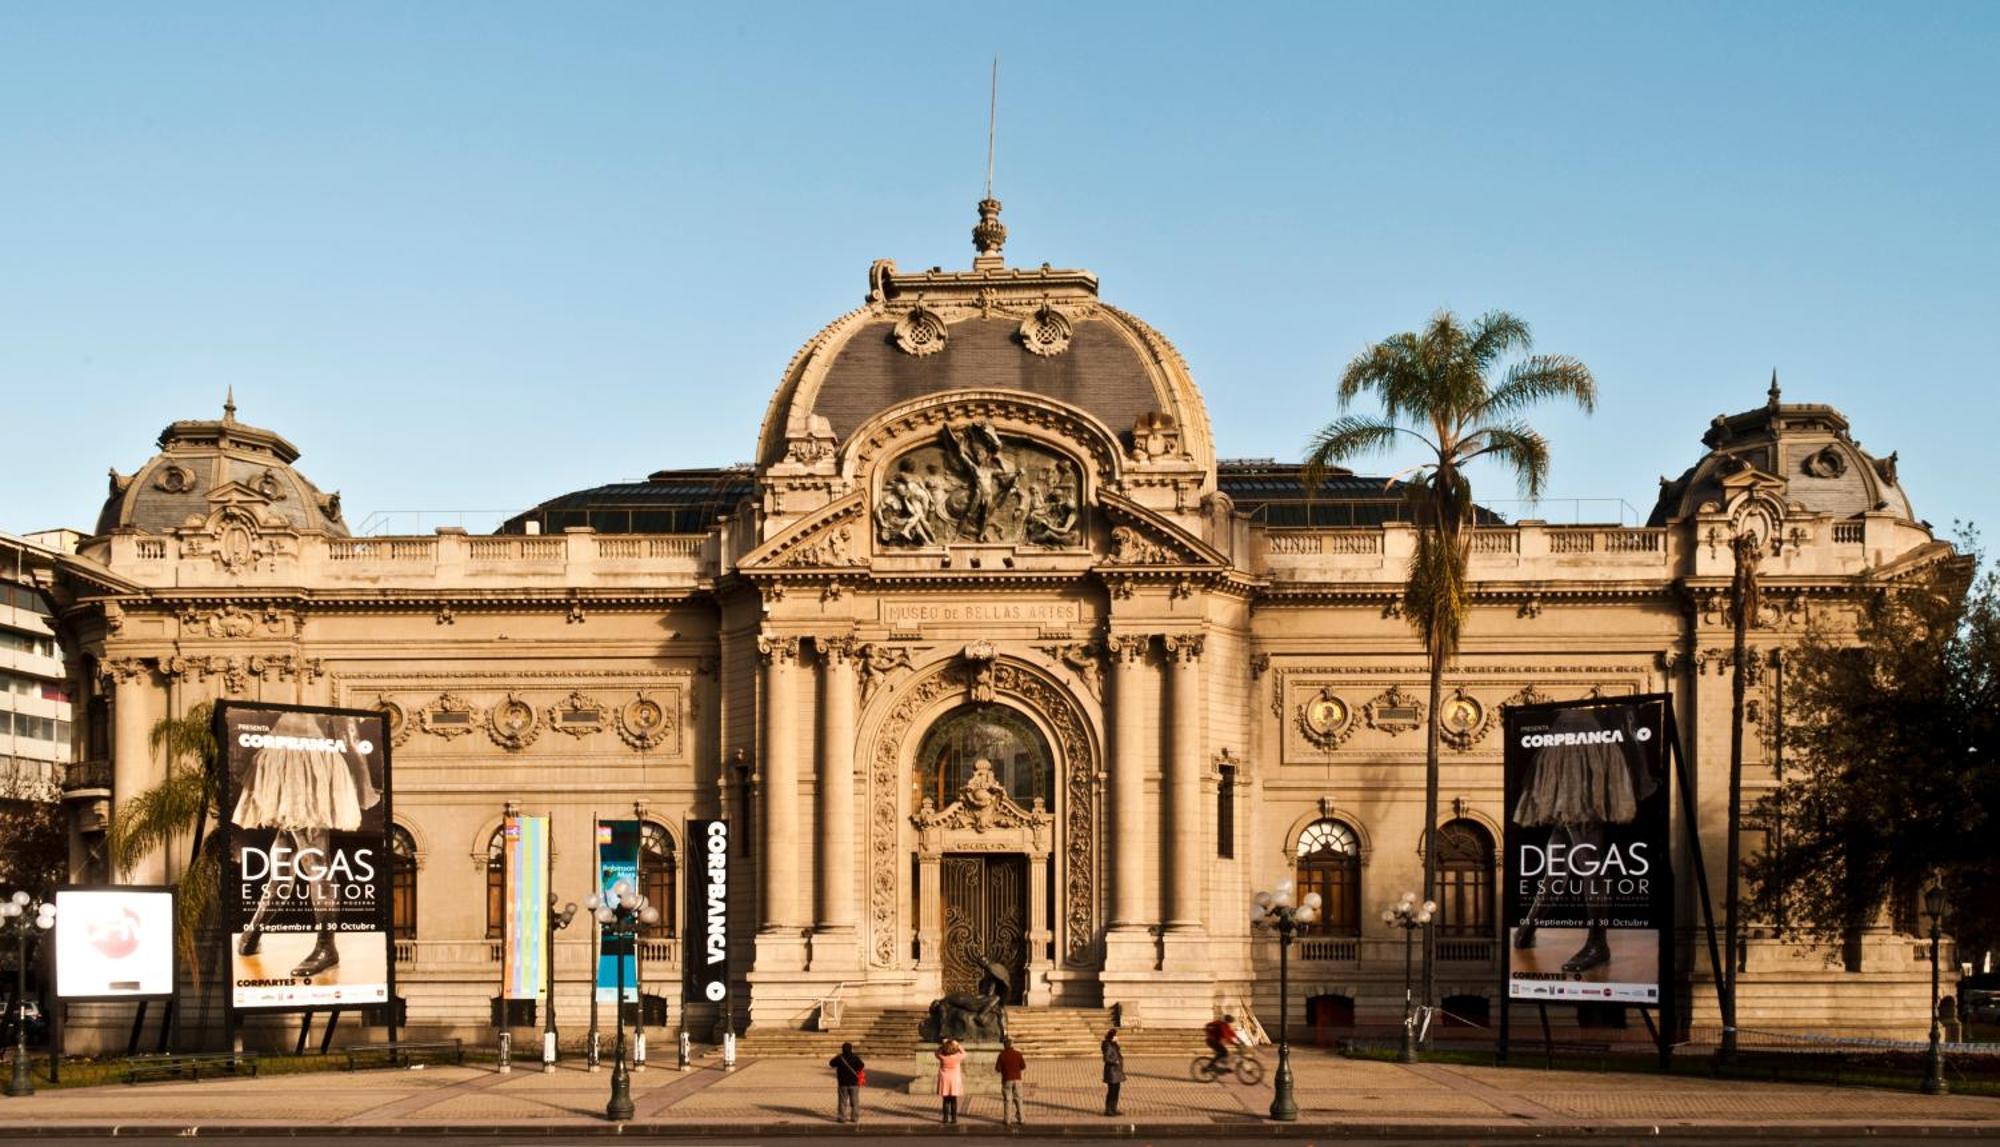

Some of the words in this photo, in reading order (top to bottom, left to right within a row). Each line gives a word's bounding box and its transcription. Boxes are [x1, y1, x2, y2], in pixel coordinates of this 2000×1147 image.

[889, 606, 938, 620] MUSEO
[966, 606, 1021, 619] BELLAS
[1029, 606, 1074, 619] ARTES
[238, 723, 270, 732] PRESENTA
[238, 733, 348, 753] CORPBANCA
[1520, 729, 1624, 748] CORPBANCA
[241, 847, 375, 881] DEGAS
[1519, 842, 1649, 877] DEGAS
[241, 883, 375, 899] ESCULTOR
[706, 820, 727, 965] CORPBANCA
[1519, 879, 1649, 895] ESCULTOR
[260, 923, 312, 933] Septiembre
[315, 922, 322, 931] al
[327, 922, 337, 931] 30
[340, 922, 376, 931] Octubre
[1534, 918, 1584, 928] Septiembre
[1612, 918, 1649, 926] Octubre
[236, 978, 296, 987] CORPARTES
